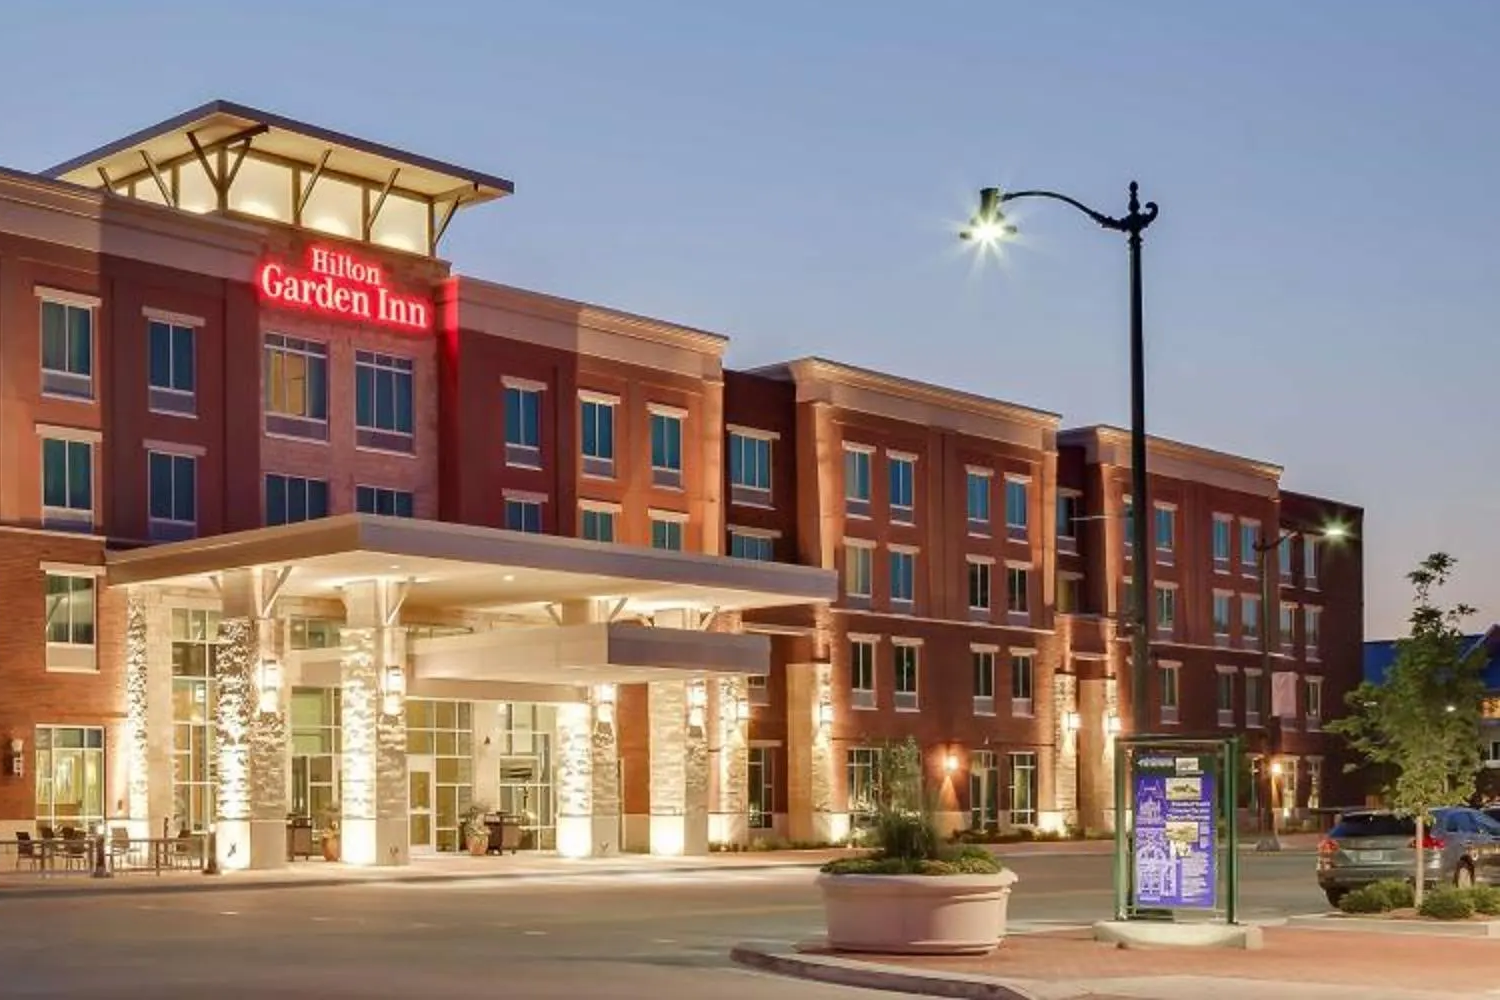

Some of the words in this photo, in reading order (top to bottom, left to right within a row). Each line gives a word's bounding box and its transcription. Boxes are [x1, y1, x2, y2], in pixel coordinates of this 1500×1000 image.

[312, 248, 381, 285] Hilton
[262, 264, 371, 317] Garden
[378, 288, 427, 328] Inn
